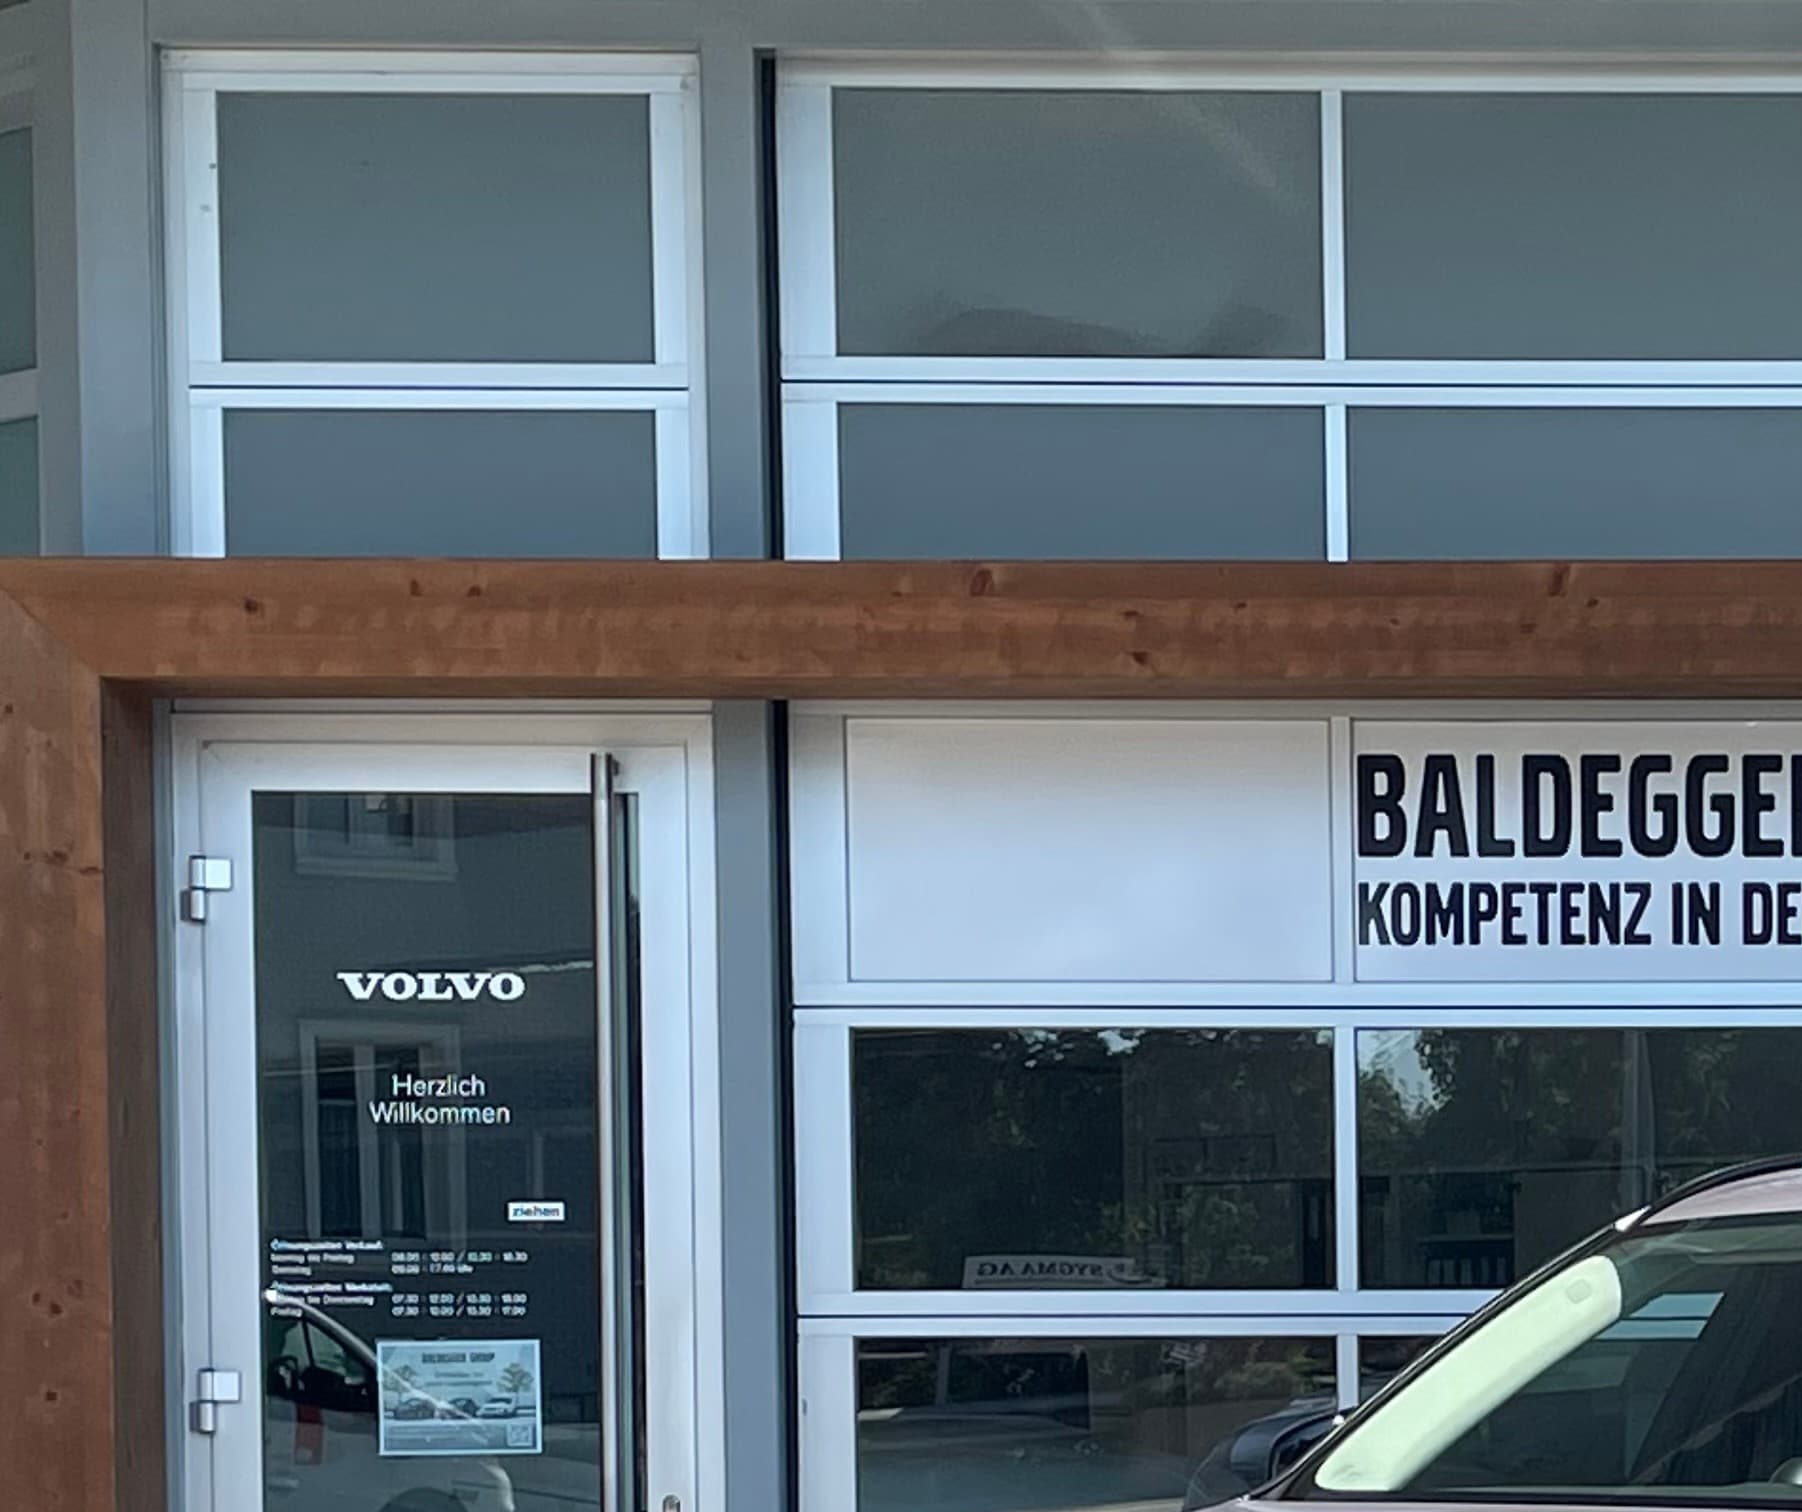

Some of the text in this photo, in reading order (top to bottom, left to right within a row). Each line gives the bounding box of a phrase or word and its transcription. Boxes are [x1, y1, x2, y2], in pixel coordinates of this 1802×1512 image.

[1358, 882, 1652, 946] KOMPETENZ
[1672, 882, 1720, 946] IN
[336, 972, 526, 1000] VOLVO
[391, 1073, 486, 1097] Herzlich
[368, 1101, 511, 1124] Willkommen
